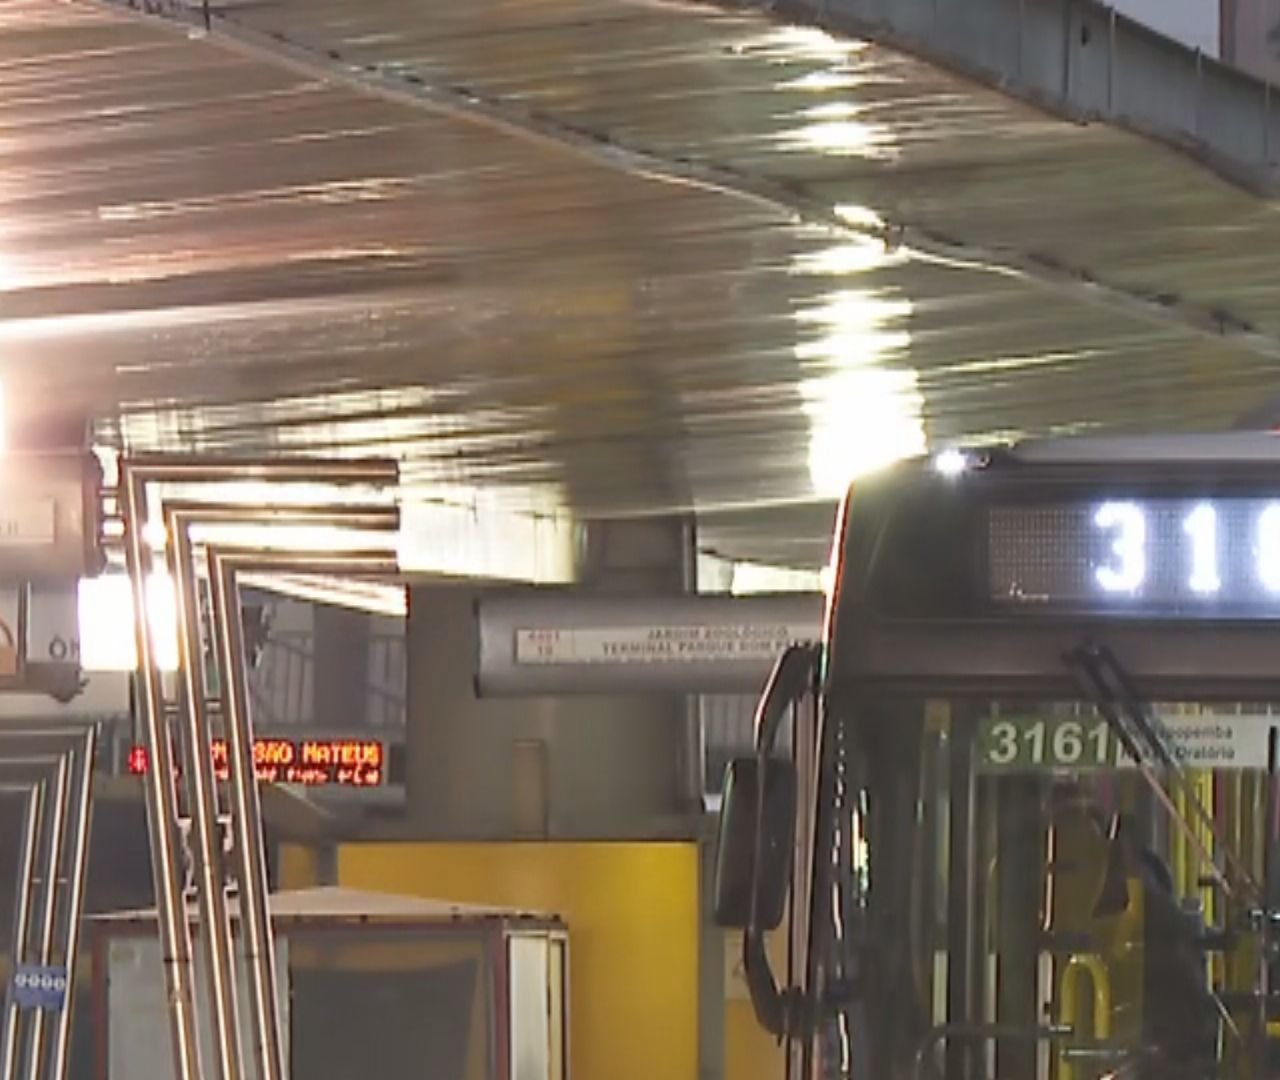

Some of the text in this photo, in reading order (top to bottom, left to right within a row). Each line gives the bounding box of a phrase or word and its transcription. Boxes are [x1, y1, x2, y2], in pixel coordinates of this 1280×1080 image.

[647, 628, 700, 641] JARDIM
[601, 641, 674, 656] TERMINAL
[678, 640, 733, 655] PARQUE
[302, 740, 381, 768] MATEUS
[988, 721, 1109, 765] 3161
